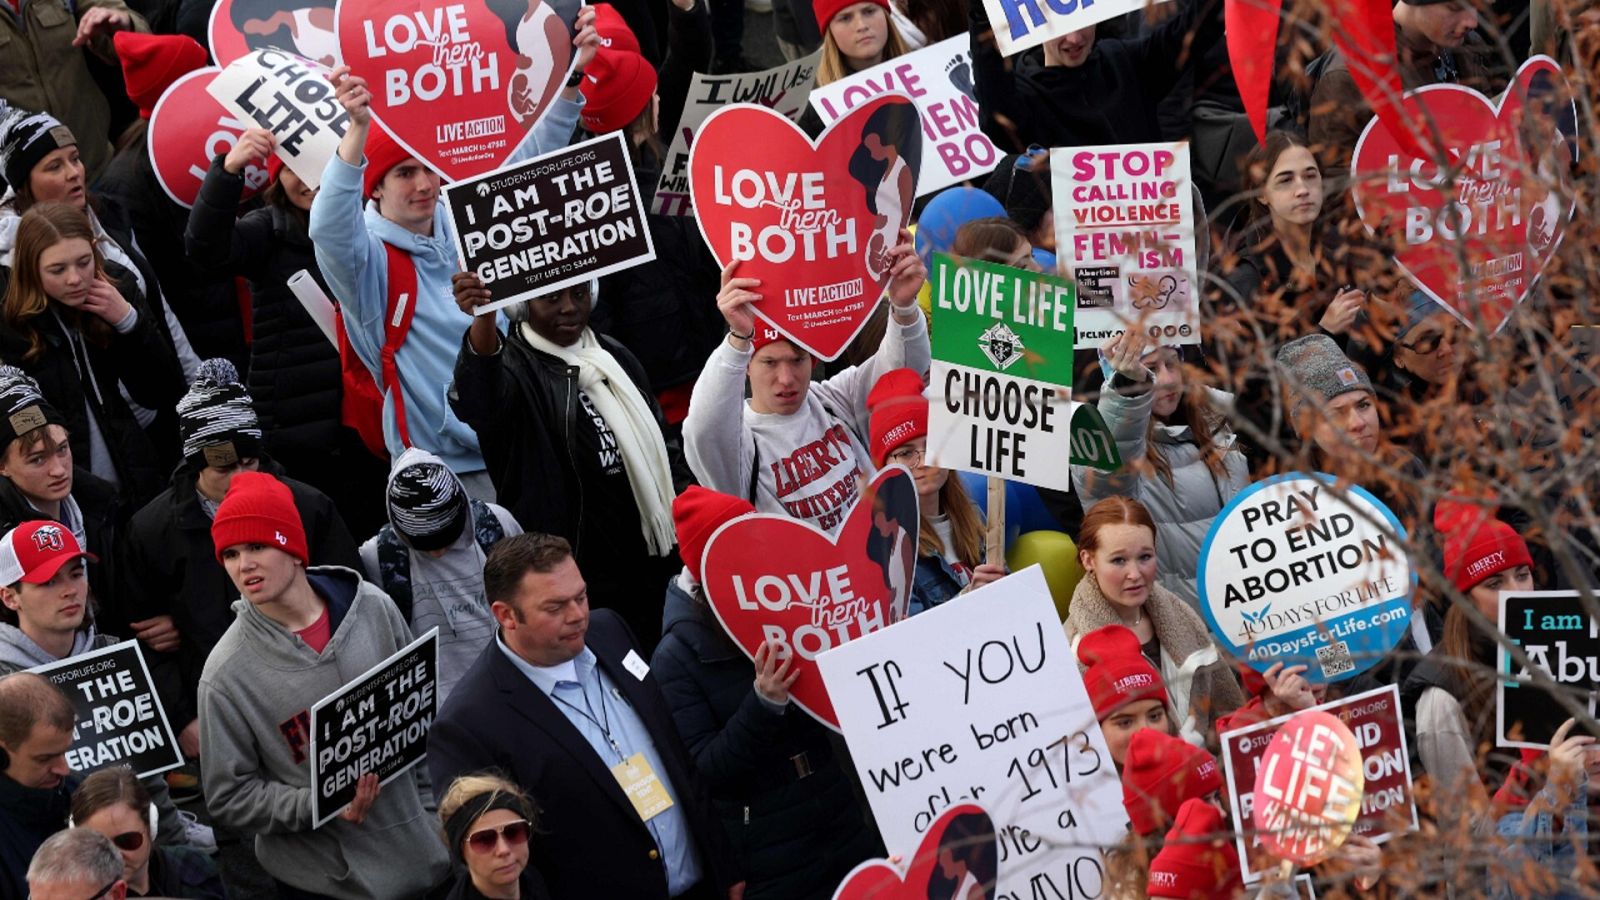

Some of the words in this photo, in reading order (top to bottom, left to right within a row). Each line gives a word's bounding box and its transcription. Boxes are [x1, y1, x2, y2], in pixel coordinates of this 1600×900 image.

[363, 4, 470, 59] LOVE
[413, 33, 485, 66] them
[385, 52, 500, 107] BOTH
[696, 79, 731, 104] I
[235, 76, 320, 158] LIFE
[436, 122, 464, 144] LIVE
[466, 116, 504, 137] ACTION
[922, 94, 980, 142] EM
[452, 144, 478, 155] MARCH
[490, 151, 597, 192] STUDENTSFORLIFE.ORG
[1072, 150, 1175, 182] STOP
[465, 204, 476, 225] I
[491, 184, 540, 218] AM
[551, 160, 615, 197] THE
[714, 164, 826, 209] LOVE
[1072, 181, 1177, 203] CALLING
[463, 183, 631, 259] POST-ROE
[759, 198, 842, 230] them
[1073, 204, 1181, 224] VIOLENCE
[1406, 187, 1521, 245] BOTH
[476, 216, 637, 284] GENERATION
[730, 217, 857, 264] BOTH
[1138, 248, 1183, 269] ISM
[525, 272, 543, 284] TEXT
[544, 267, 561, 278] LIFE
[561, 263, 572, 272] TO
[785, 287, 818, 308] LIVE
[820, 279, 862, 302] ACTION
[1078, 268, 1116, 277] Abortion
[787, 313, 803, 321] Text
[803, 308, 834, 320] MARCH
[938, 264, 1006, 320] LOVE
[1013, 278, 1069, 332] LIFE
[944, 368, 1055, 433] CHOOSE
[770, 423, 852, 499] LIBERTY
[970, 424, 1026, 478] LIFE
[1241, 486, 1320, 533] PRAY
[274, 530, 287, 546] LU
[1230, 537, 1276, 569] TO
[1284, 513, 1355, 553] END
[1224, 534, 1389, 609] ABORTION
[1467, 550, 1504, 576] LIBERTY
[732, 564, 854, 612] LOVE
[786, 595, 870, 628] them
[762, 600, 885, 662] BOTH
[1248, 606, 1407, 663] 40DaysForLife.com
[1523, 609, 1534, 631] I
[1540, 612, 1583, 631] am
[77, 669, 136, 703] THE
[856, 660, 910, 730] If
[943, 622, 1046, 705] YOU
[1113, 673, 1152, 693] LIBERTY
[324, 722, 330, 741] I
[341, 694, 376, 731] AM
[385, 660, 427, 701] THE
[319, 680, 434, 775] POST-ROE
[1291, 724, 1345, 771] LET
[322, 711, 433, 799] GENERATION
[868, 743, 957, 792] were
[970, 711, 1038, 750] born
[914, 786, 985, 833] aftr
[1007, 731, 1101, 802] 1973
[1262, 753, 1356, 822] LIFE
[1058, 809, 1077, 829] a
